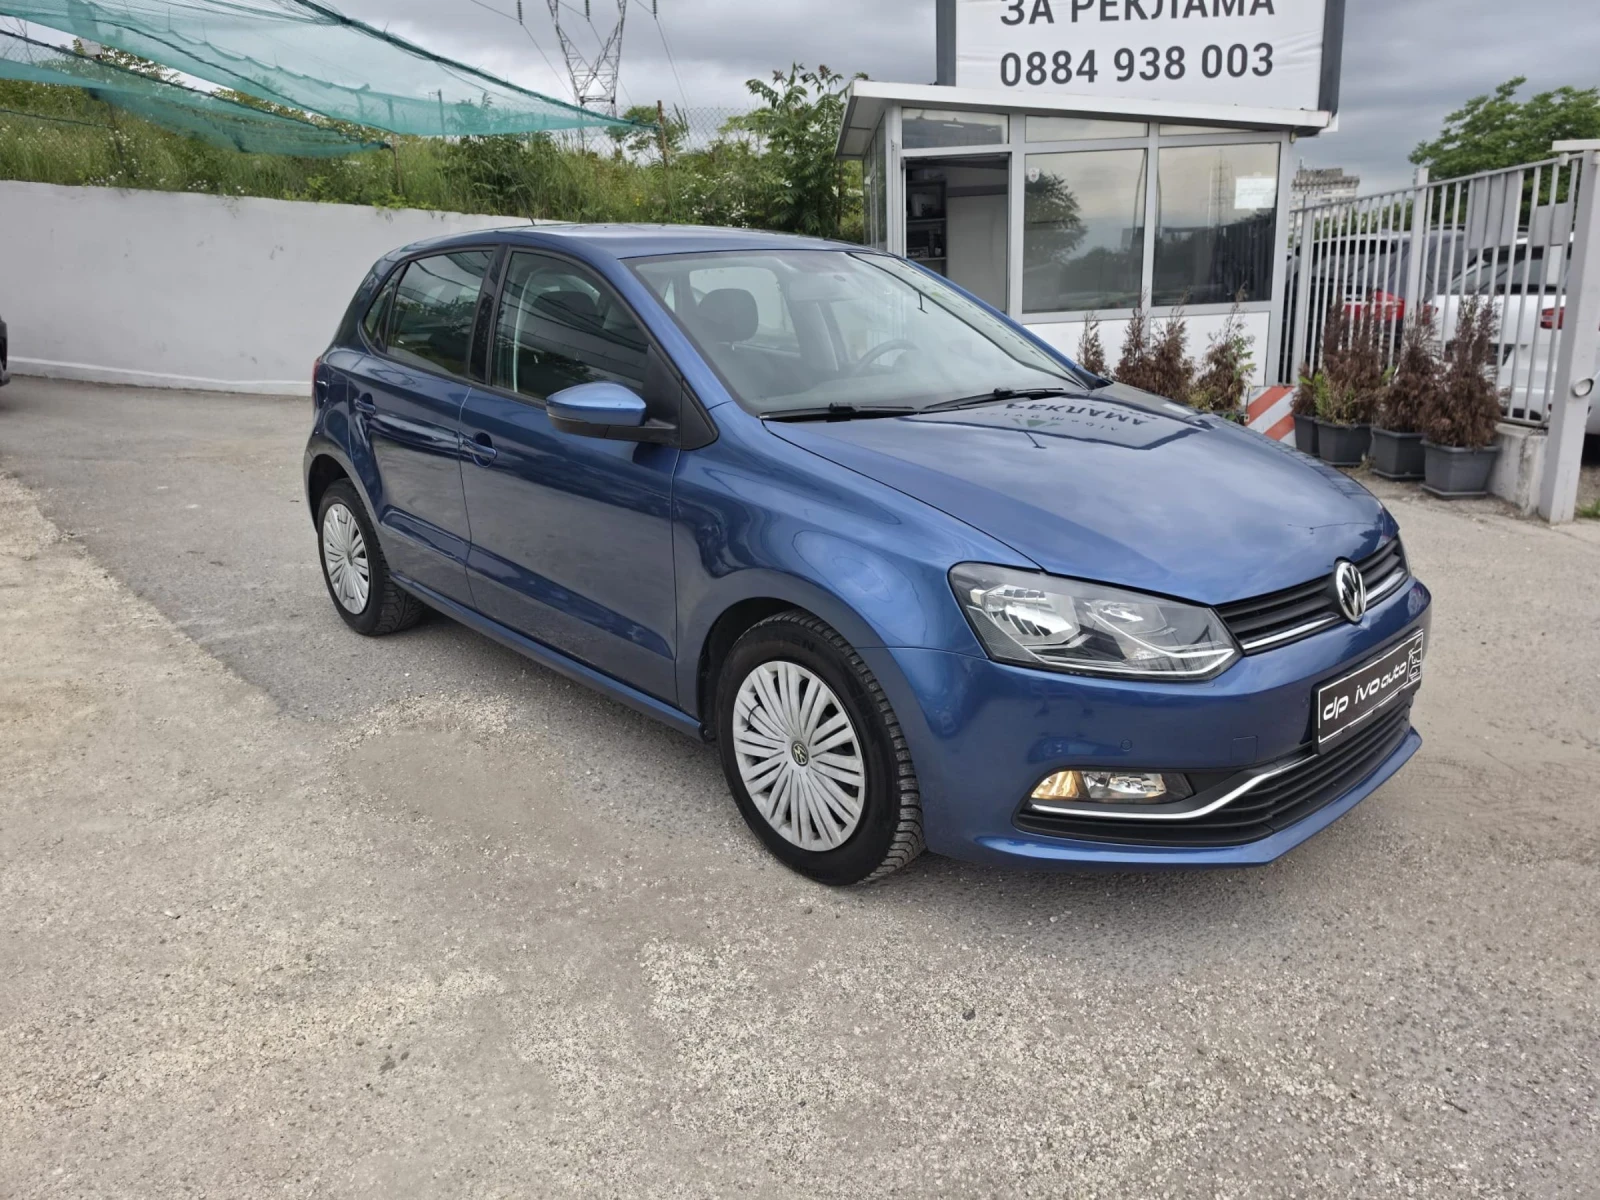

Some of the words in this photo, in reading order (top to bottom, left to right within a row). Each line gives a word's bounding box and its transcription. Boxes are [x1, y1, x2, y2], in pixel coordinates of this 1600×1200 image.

[1000, 0, 1055, 25] ЗА
[1000, 49, 1098, 87] 0884
[1114, 46, 1186, 82] 938
[1201, 42, 1273, 78] 003
[1323, 695, 1349, 721] dp
